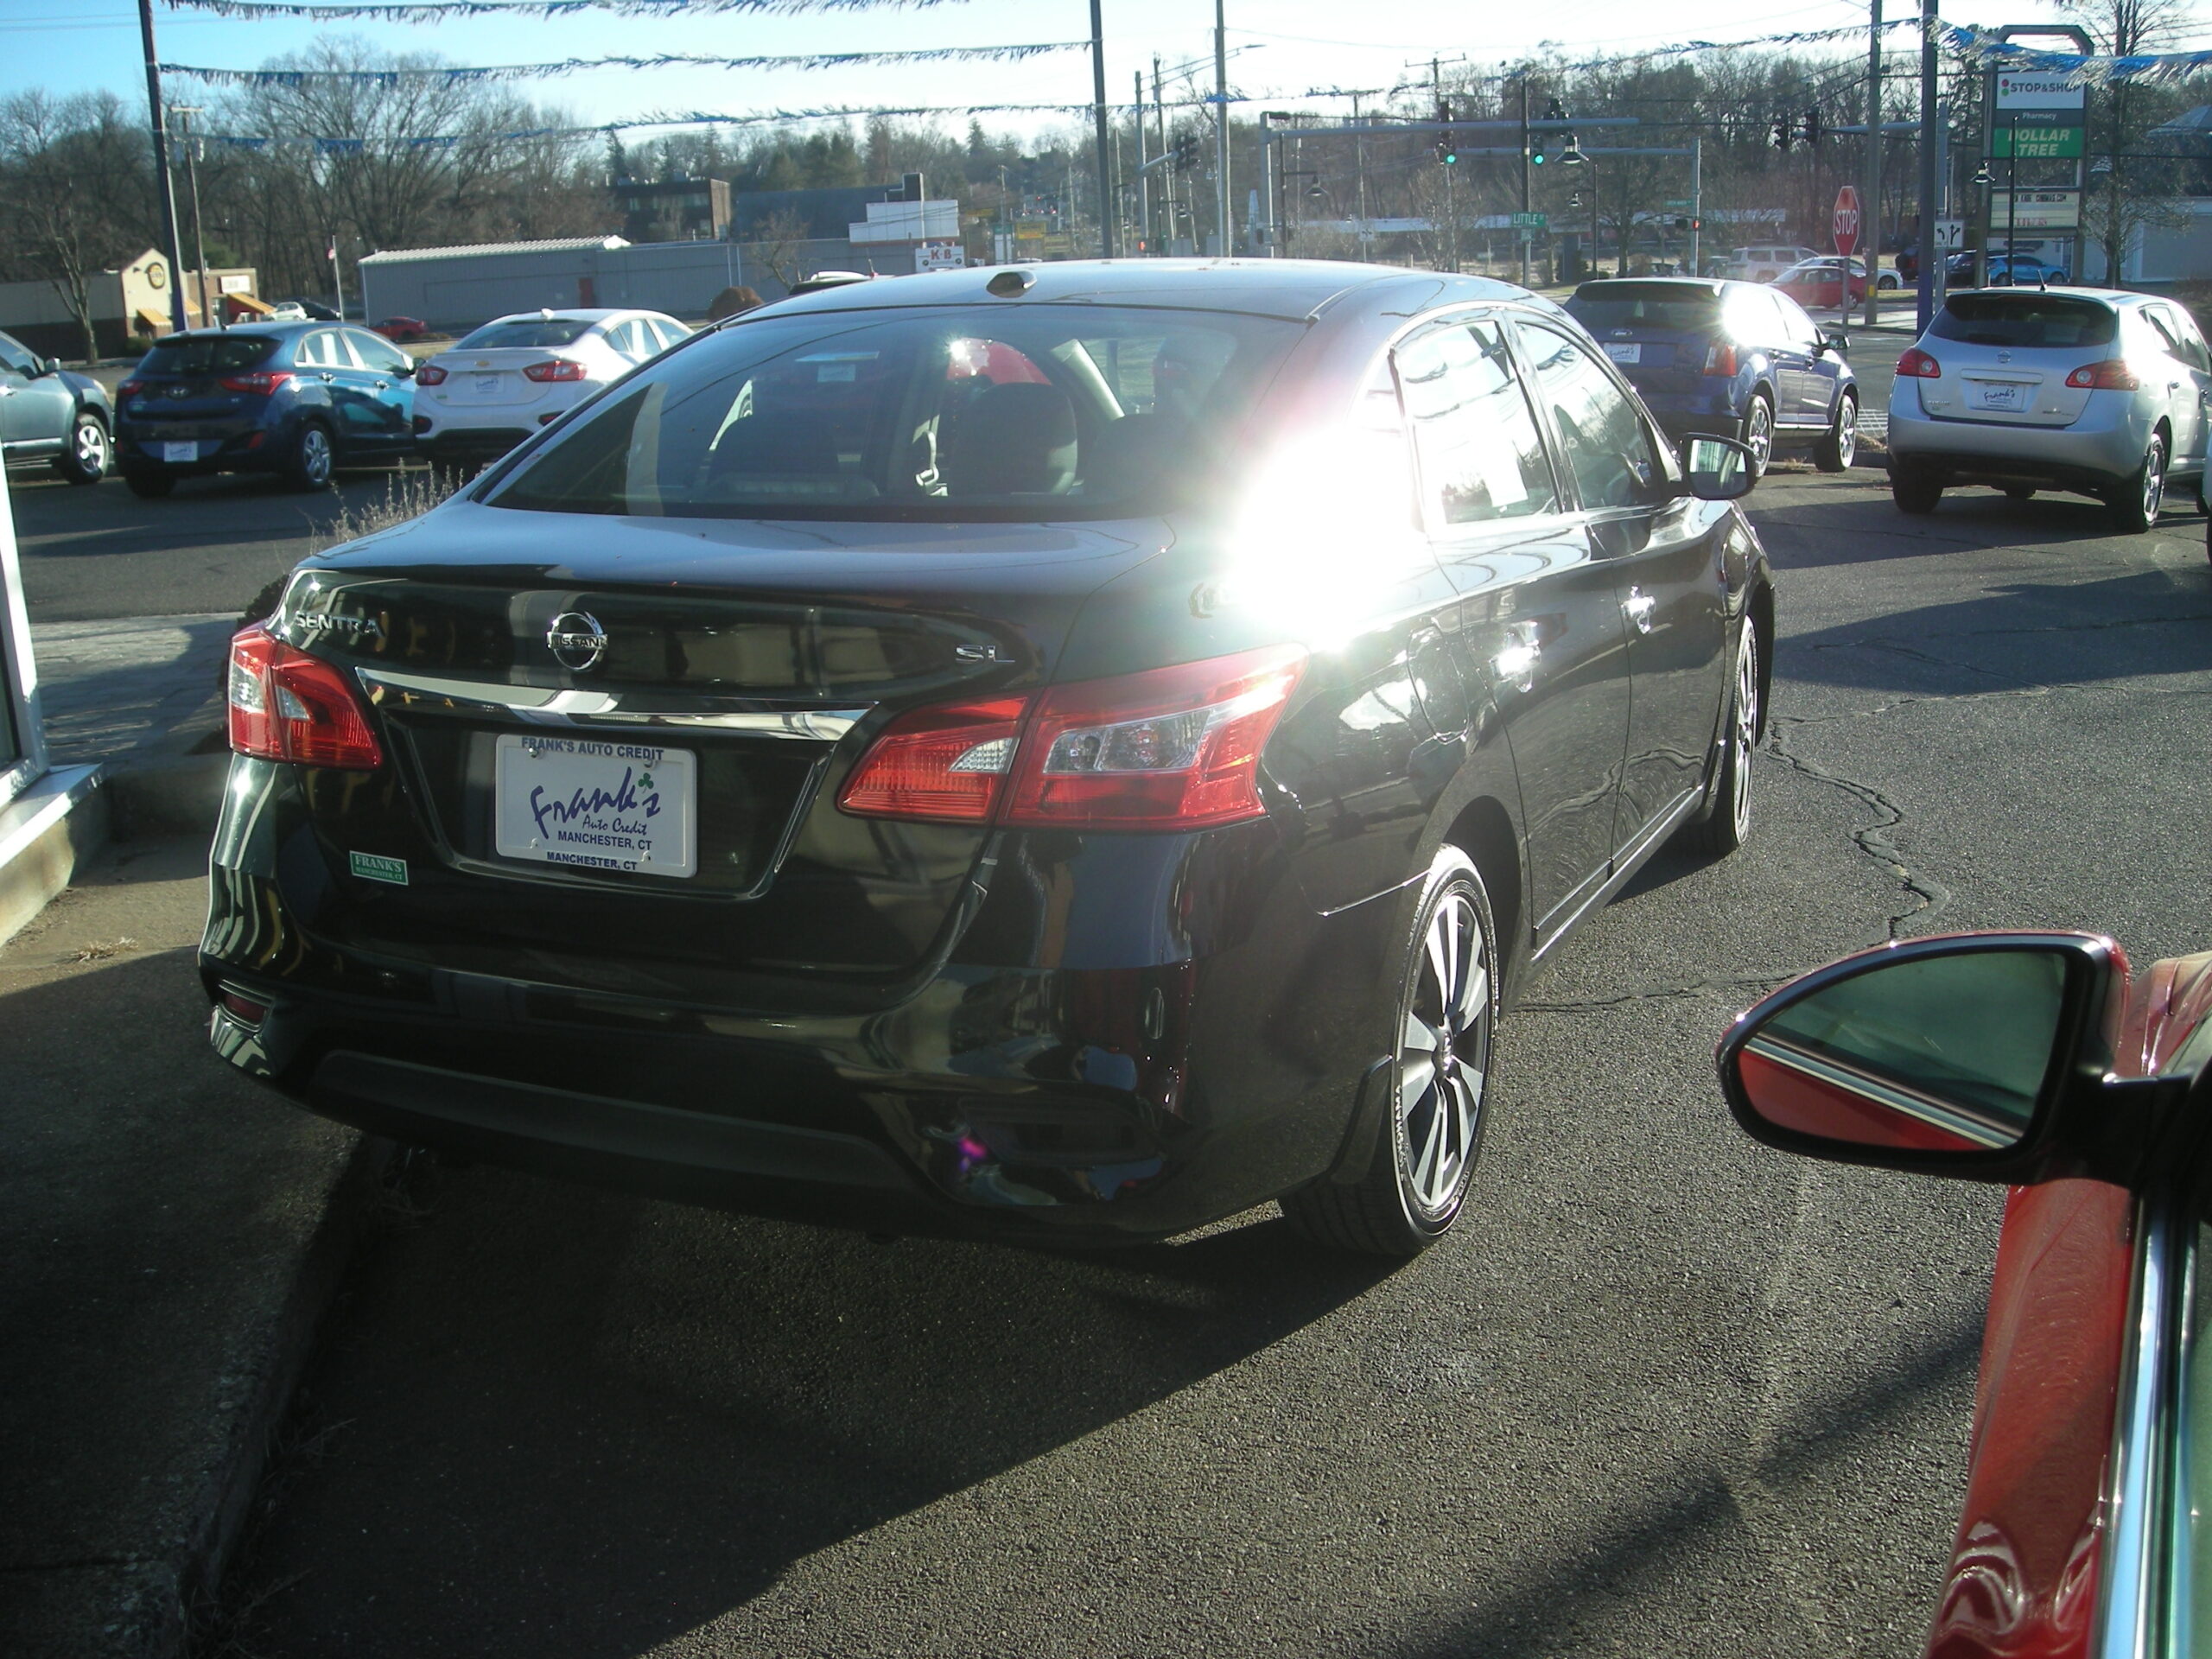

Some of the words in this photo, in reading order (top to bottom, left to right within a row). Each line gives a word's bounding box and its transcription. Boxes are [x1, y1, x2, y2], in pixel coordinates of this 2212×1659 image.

[2022, 112, 2057, 121] Pharmacy
[2008, 129, 2071, 142] DOLLAR
[2018, 143, 2059, 156] TREE
[1513, 213, 1538, 225] LITTLE
[1835, 210, 1858, 235] STOP
[295, 610, 385, 637] SENTRA
[551, 634, 600, 648] NISSAN
[955, 644, 1016, 664] SL
[522, 737, 575, 753] FRANK'S
[578, 742, 613, 757] AUTO
[617, 746, 664, 761] CREDIT
[531, 766, 661, 839] Frank's
[582, 814, 609, 831] Auto
[612, 817, 647, 836] Credit
[557, 830, 635, 850] MANCHESTER,
[638, 839, 652, 851] CT
[355, 855, 401, 872] FRANK'S
[547, 852, 621, 869] MANCHESTER,
[624, 861, 639, 871] CT
